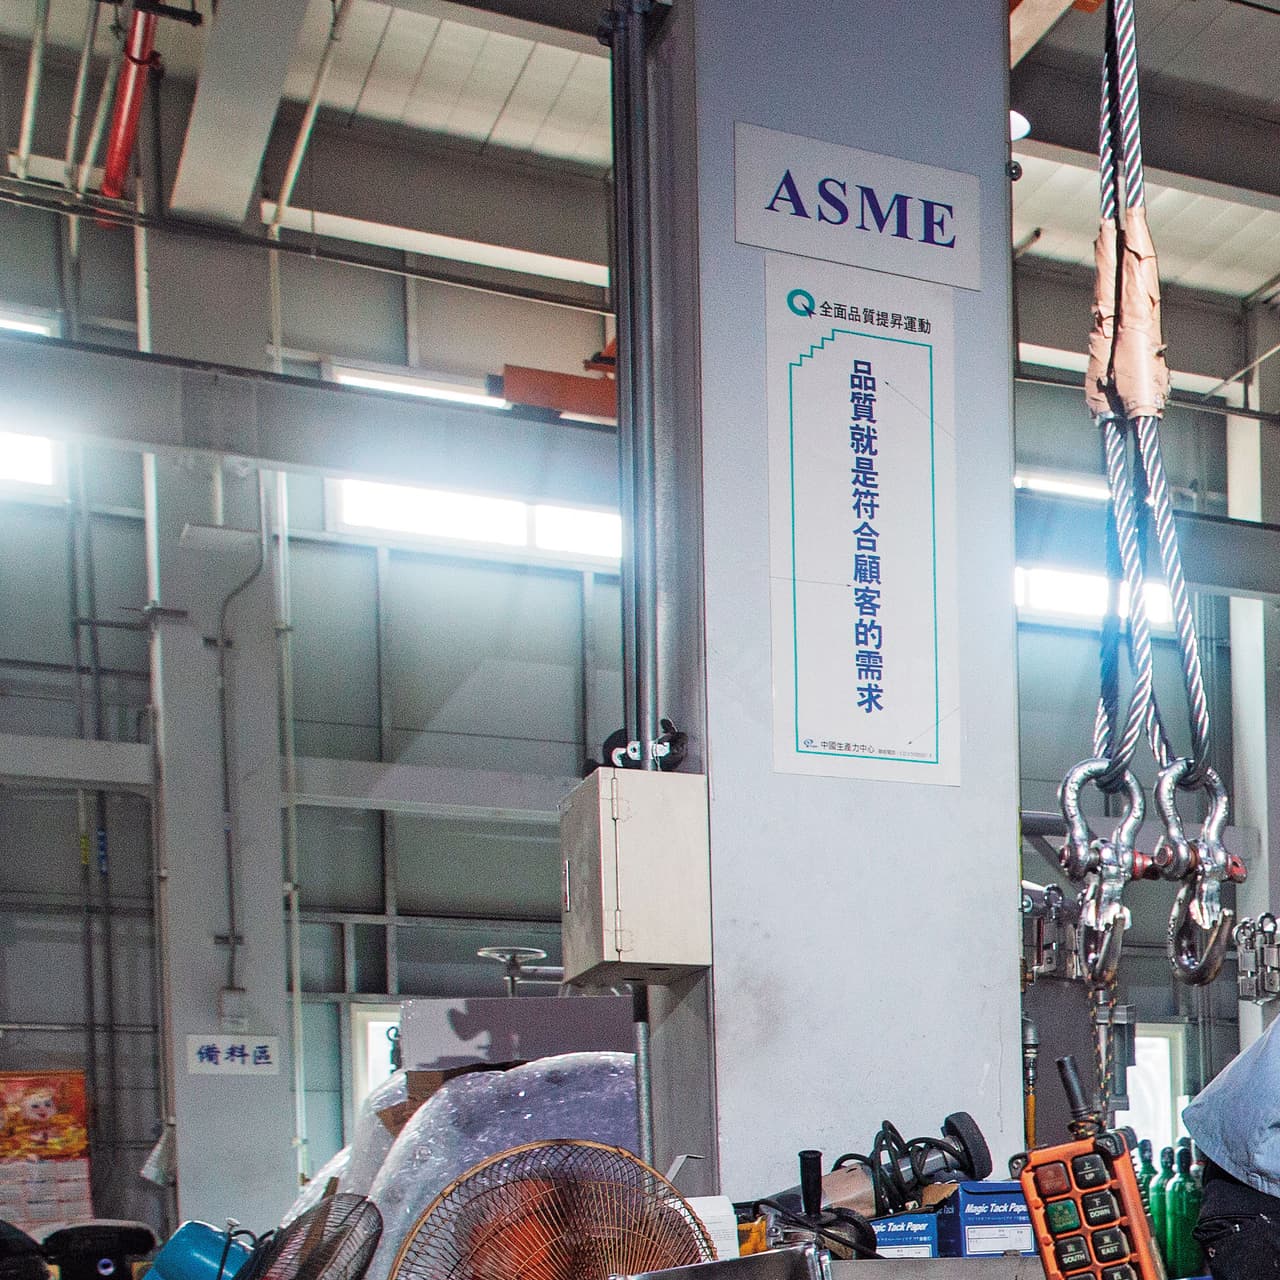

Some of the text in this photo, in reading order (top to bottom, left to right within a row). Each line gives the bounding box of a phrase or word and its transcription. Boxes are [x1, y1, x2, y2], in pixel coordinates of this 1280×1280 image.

[765, 169, 957, 248] ASME
[819, 301, 932, 335] 全面品質提昇運動
[850, 360, 884, 713] 品質就是符合顧客的需求
[196, 1043, 273, 1066] 備料區
[965, 1203, 1028, 1215] Magic Tack Pape
[1090, 1208, 1111, 1218] DOWN
[888, 1222, 905, 1232] Tack
[905, 1222, 929, 1232] Paper
[1101, 1246, 1119, 1255] EAST
[1063, 1254, 1085, 1264] SOUTH
